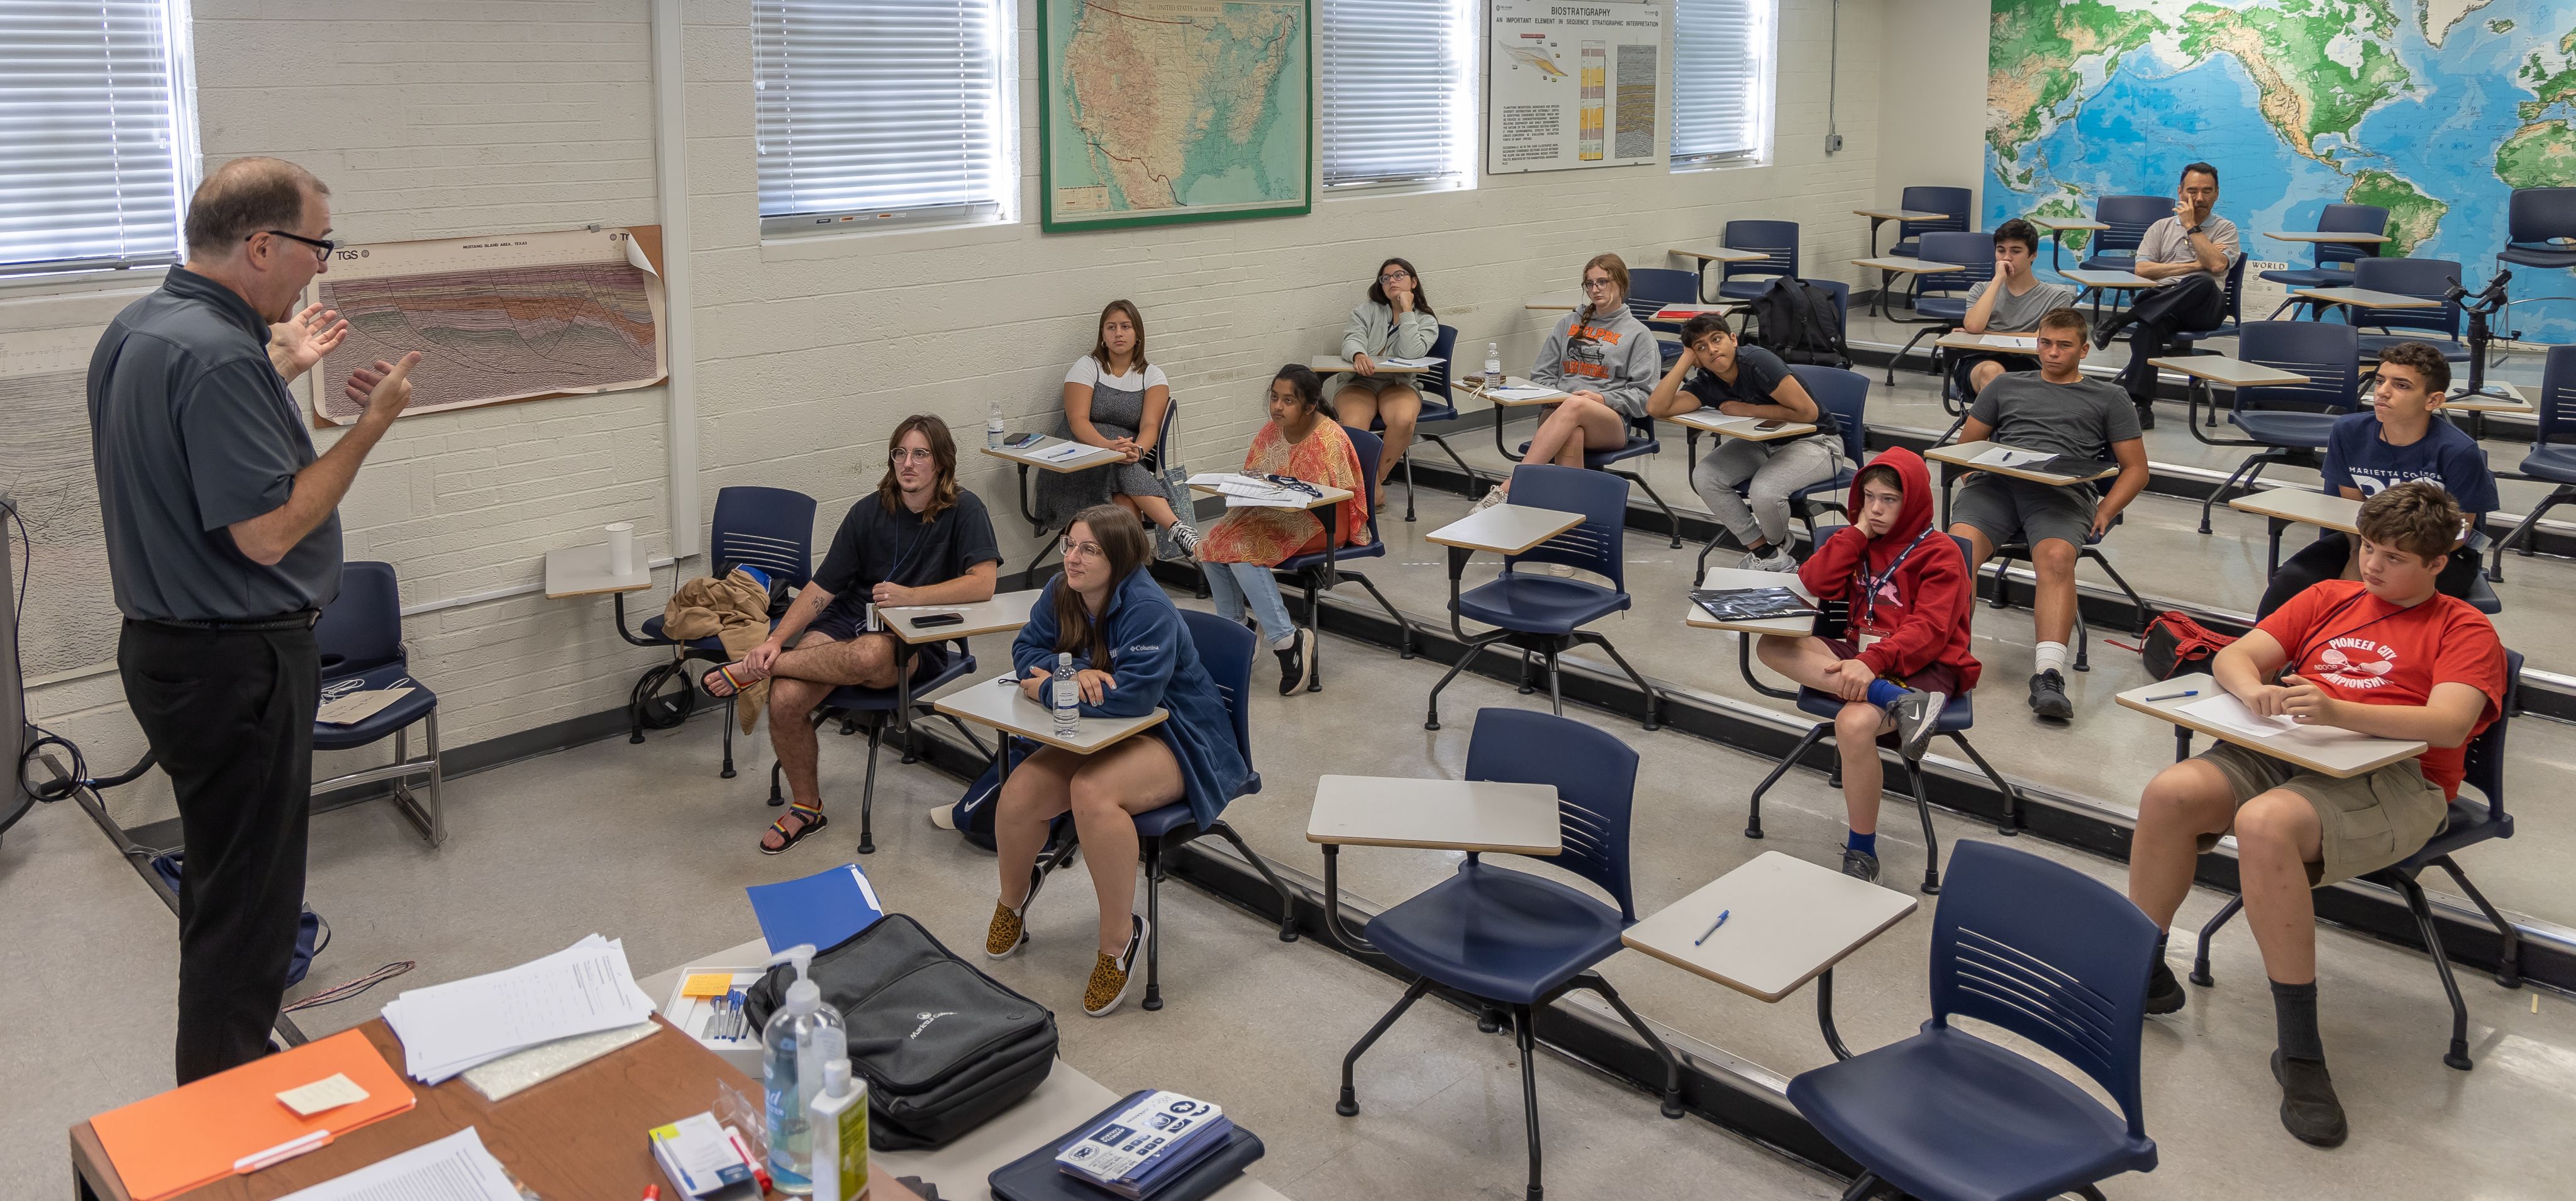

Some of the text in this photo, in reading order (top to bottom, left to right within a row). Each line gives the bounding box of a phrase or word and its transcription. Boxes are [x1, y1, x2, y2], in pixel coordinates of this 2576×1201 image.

[1551, 6, 1611, 16] BIOSTRATIGRAPHY
[336, 250, 358, 260] TGS
[2252, 261, 2285, 270] WORLD
[2349, 467, 2399, 477] MARIETTA
[2328, 637, 2397, 661] PIONEER CITY
[910, 1017, 935, 1040] Marietta
